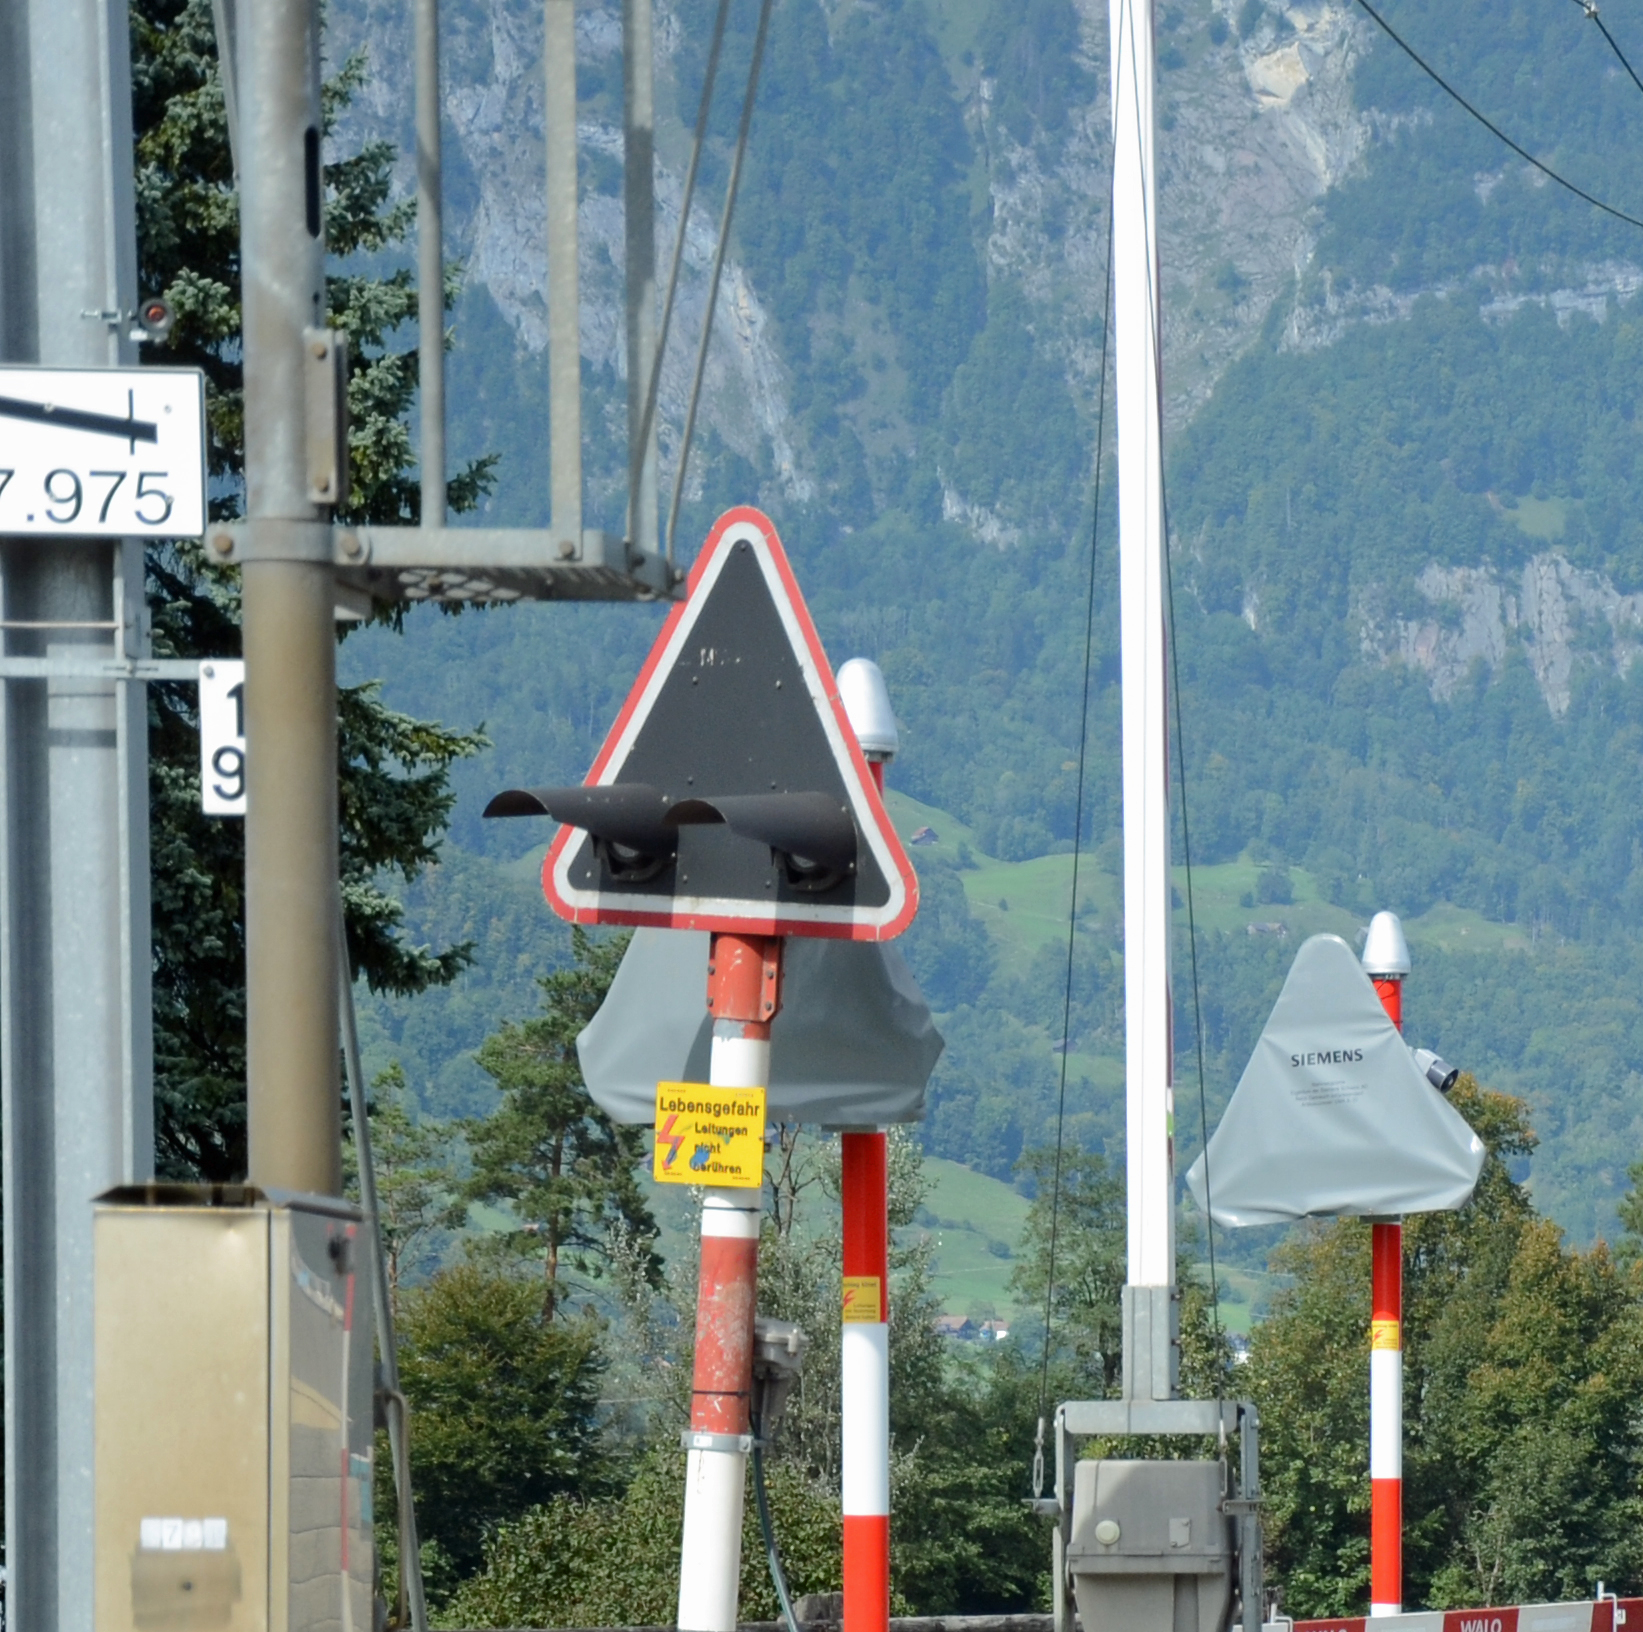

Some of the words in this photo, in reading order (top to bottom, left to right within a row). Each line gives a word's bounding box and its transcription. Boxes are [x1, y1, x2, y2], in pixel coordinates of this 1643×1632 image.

[1291, 1048, 1363, 1068] SIEMENS
[660, 1097, 760, 1118] Lebensgefahr
[695, 1122, 748, 1138] Leitungen
